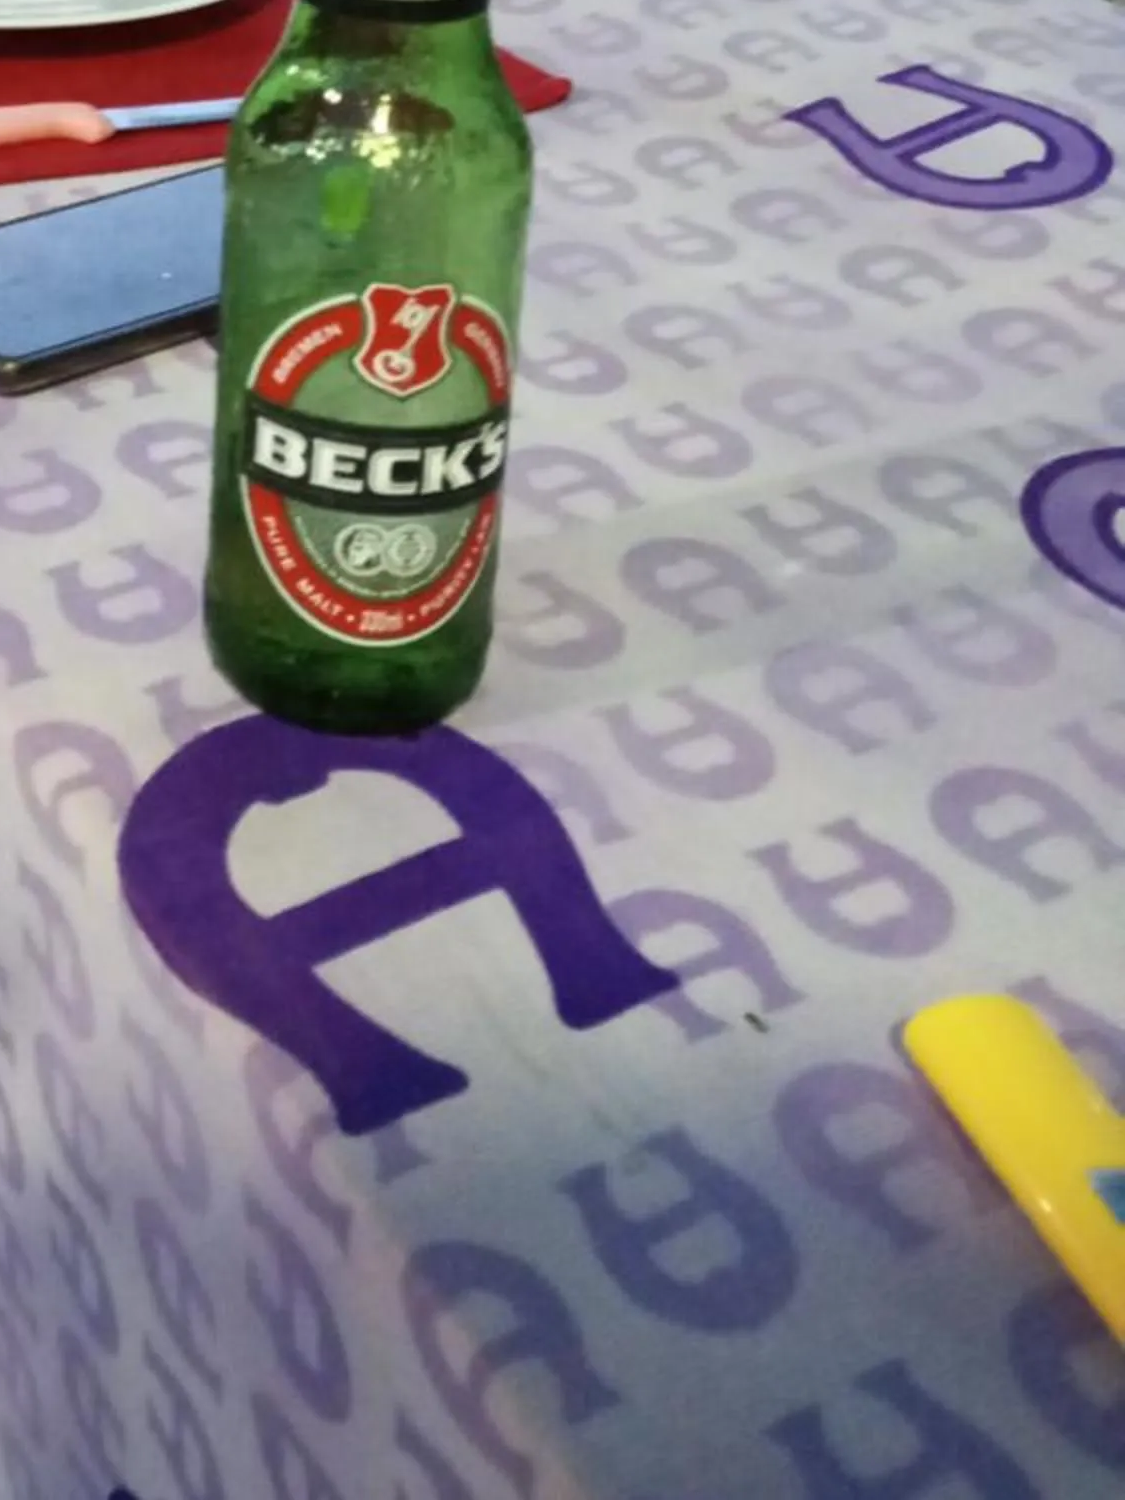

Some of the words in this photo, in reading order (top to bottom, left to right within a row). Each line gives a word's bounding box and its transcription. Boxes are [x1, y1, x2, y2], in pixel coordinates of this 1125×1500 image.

[252, 415, 508, 497] BECK'S
[262, 515, 298, 571] PURE
[295, 577, 345, 617] MALT
